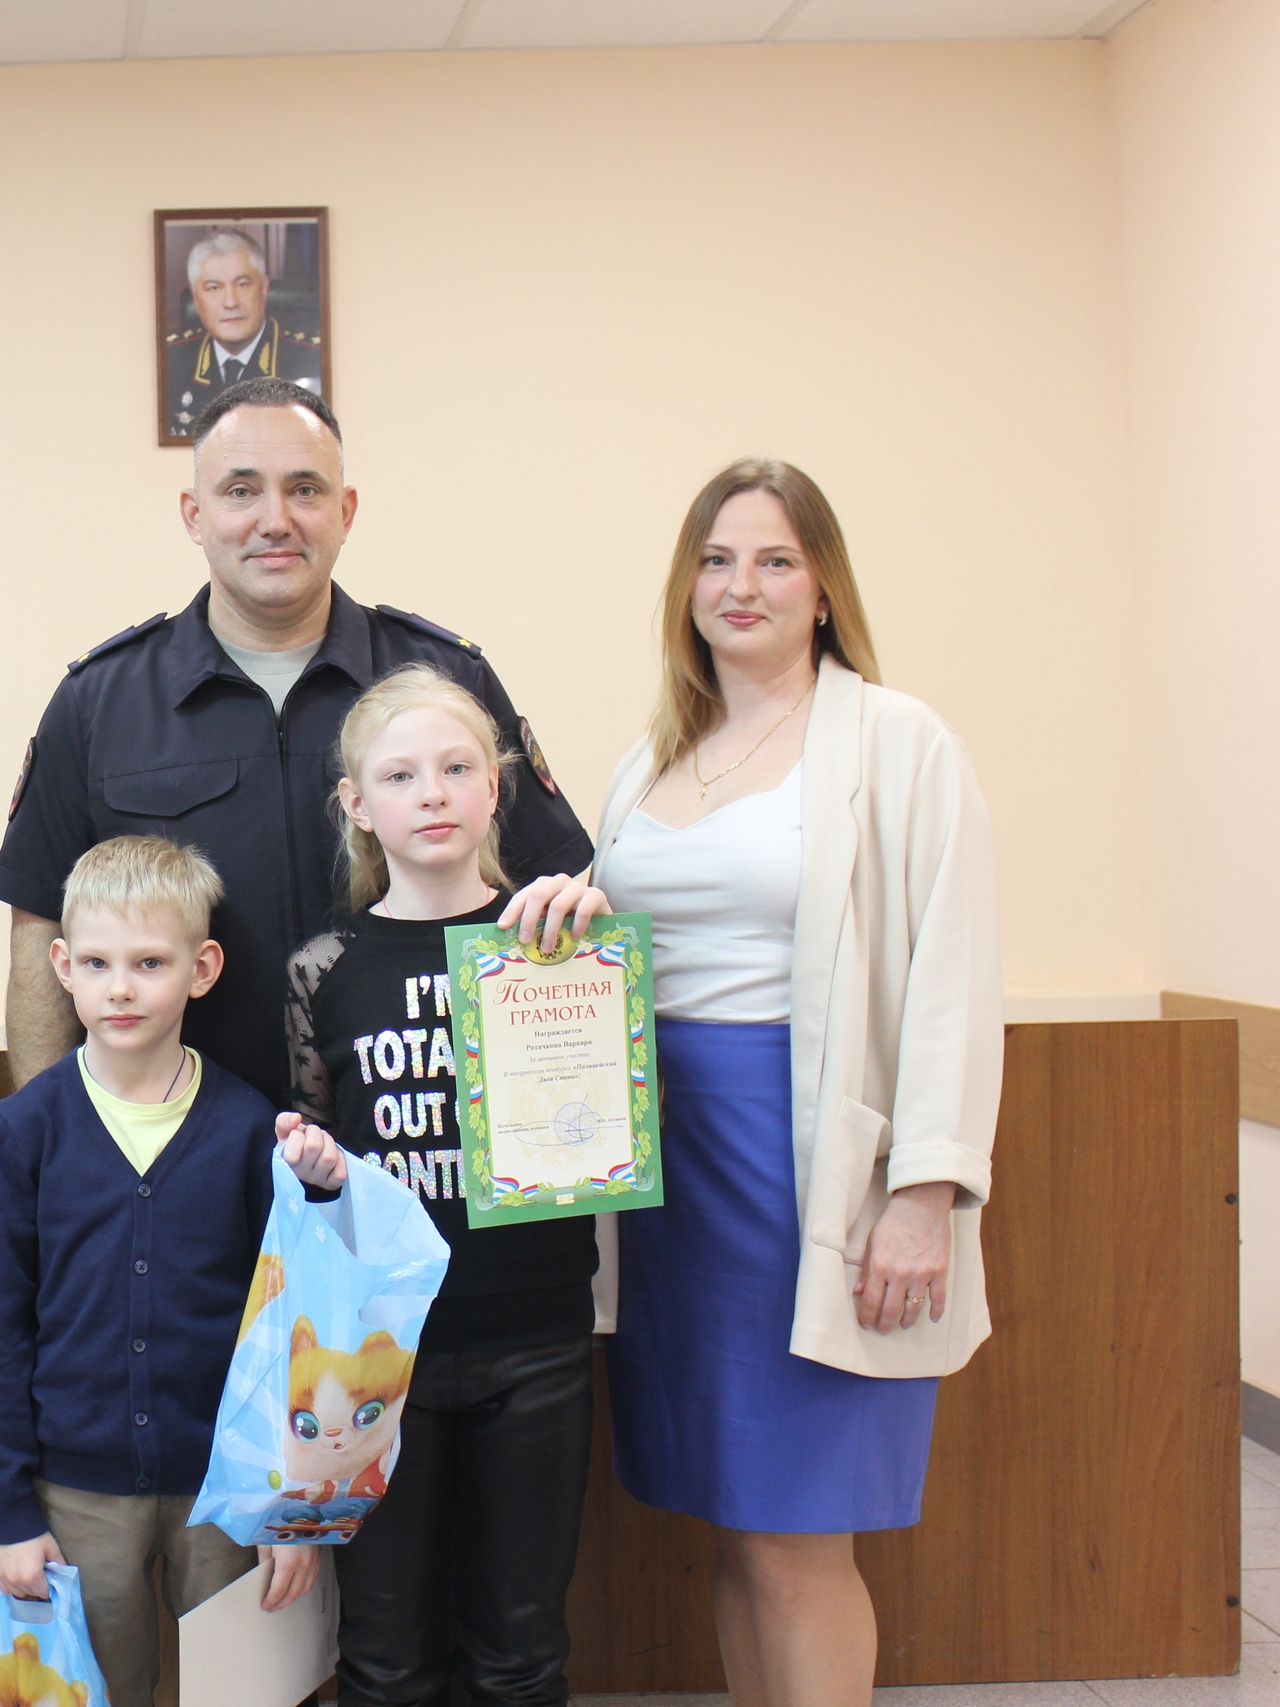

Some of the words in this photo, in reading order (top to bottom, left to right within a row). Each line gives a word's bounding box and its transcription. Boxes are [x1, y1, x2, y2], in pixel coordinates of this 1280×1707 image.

[493, 977, 613, 1005] ПОЧЕТНАЯ
[510, 1004, 597, 1026] ГРАМОТА
[534, 1028, 582, 1038] Награждается
[563, 1039, 592, 1049] Варвара
[353, 1027, 457, 1085] TOTA
[566, 1052, 591, 1060] участие
[545, 1065, 572, 1074] конкурсе
[373, 1092, 447, 1140] OUT
